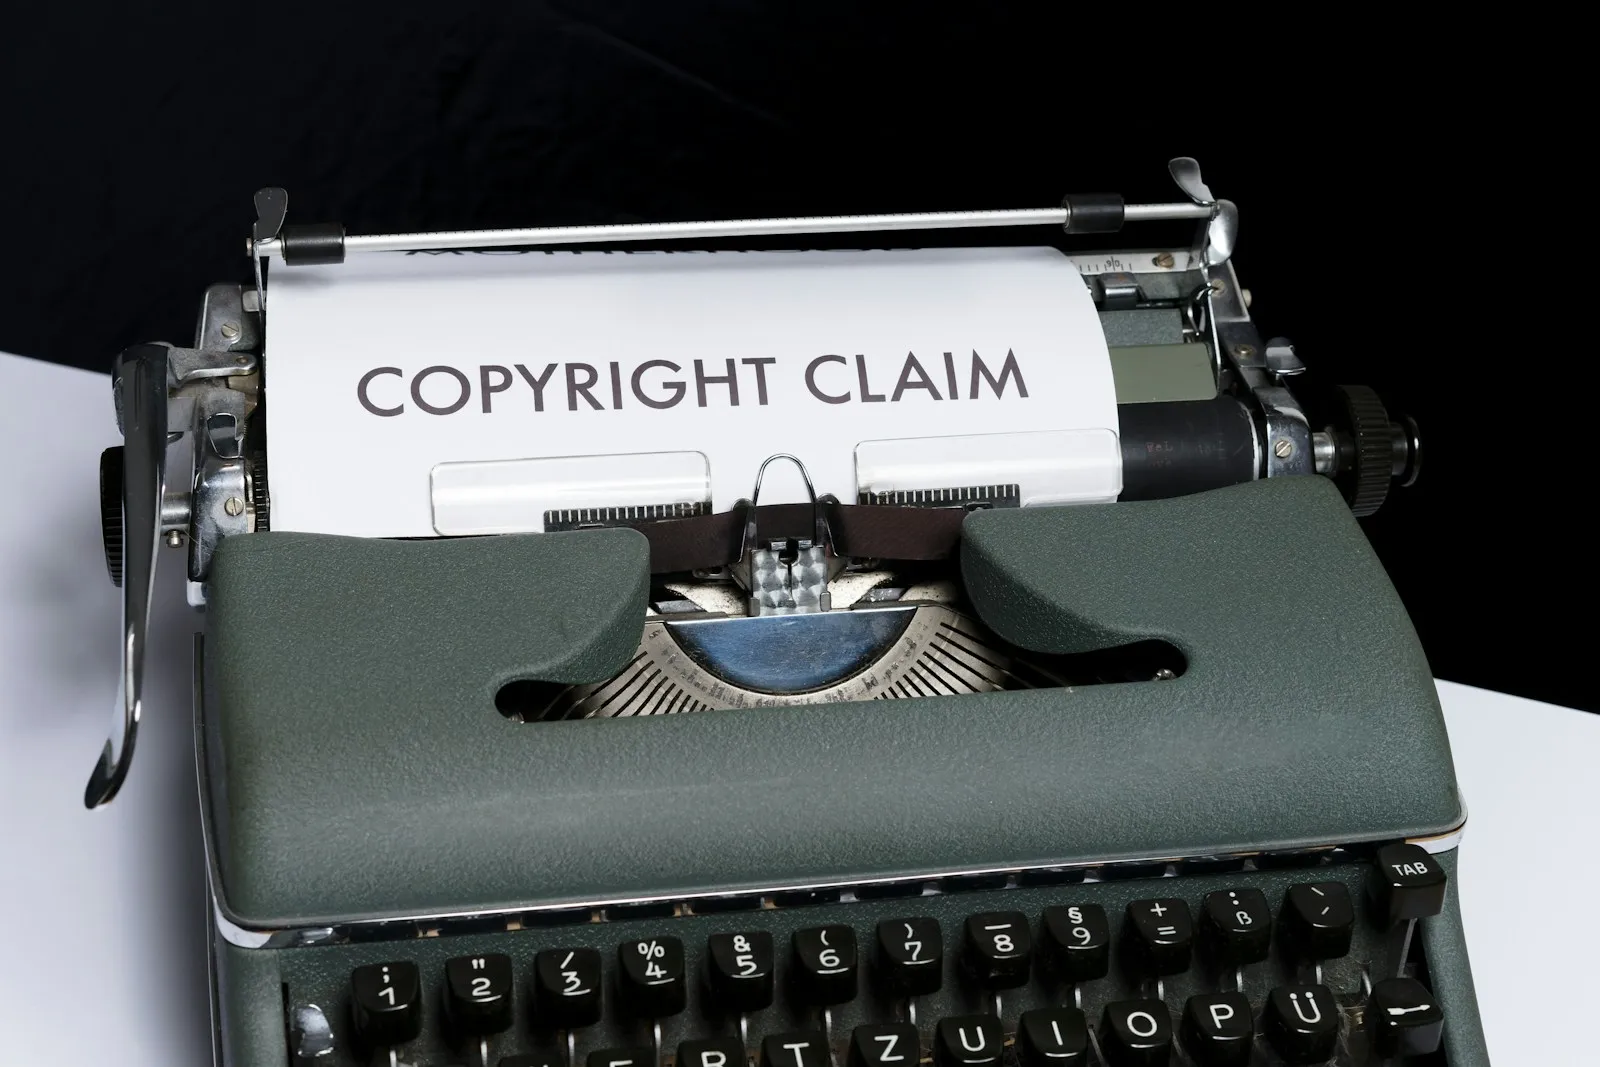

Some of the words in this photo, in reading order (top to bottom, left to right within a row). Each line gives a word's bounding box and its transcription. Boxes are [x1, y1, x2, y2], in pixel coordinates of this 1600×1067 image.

[358, 358, 776, 416] COPYRIGHT
[805, 348, 1028, 404] CLAIM
[1392, 862, 1427, 876] TAB
[733, 934, 752, 952] &
[993, 934, 1015, 953] 8
[1072, 927, 1091, 946] 9
[637, 940, 665, 960] %
[819, 948, 840, 968] 6
[904, 940, 922, 960] 7
[645, 962, 667, 978] 4
[736, 954, 758, 976] 5
[472, 977, 491, 997] 2
[562, 971, 581, 990] 3
[378, 986, 395, 1005] 1
[1209, 1003, 1234, 1029] P
[1289, 991, 1322, 1024] Ü
[1051, 1020, 1064, 1046] I
[1126, 1011, 1158, 1037] O
[874, 1034, 905, 1062] Z
[958, 1025, 986, 1052] U
[783, 1042, 810, 1067] T
